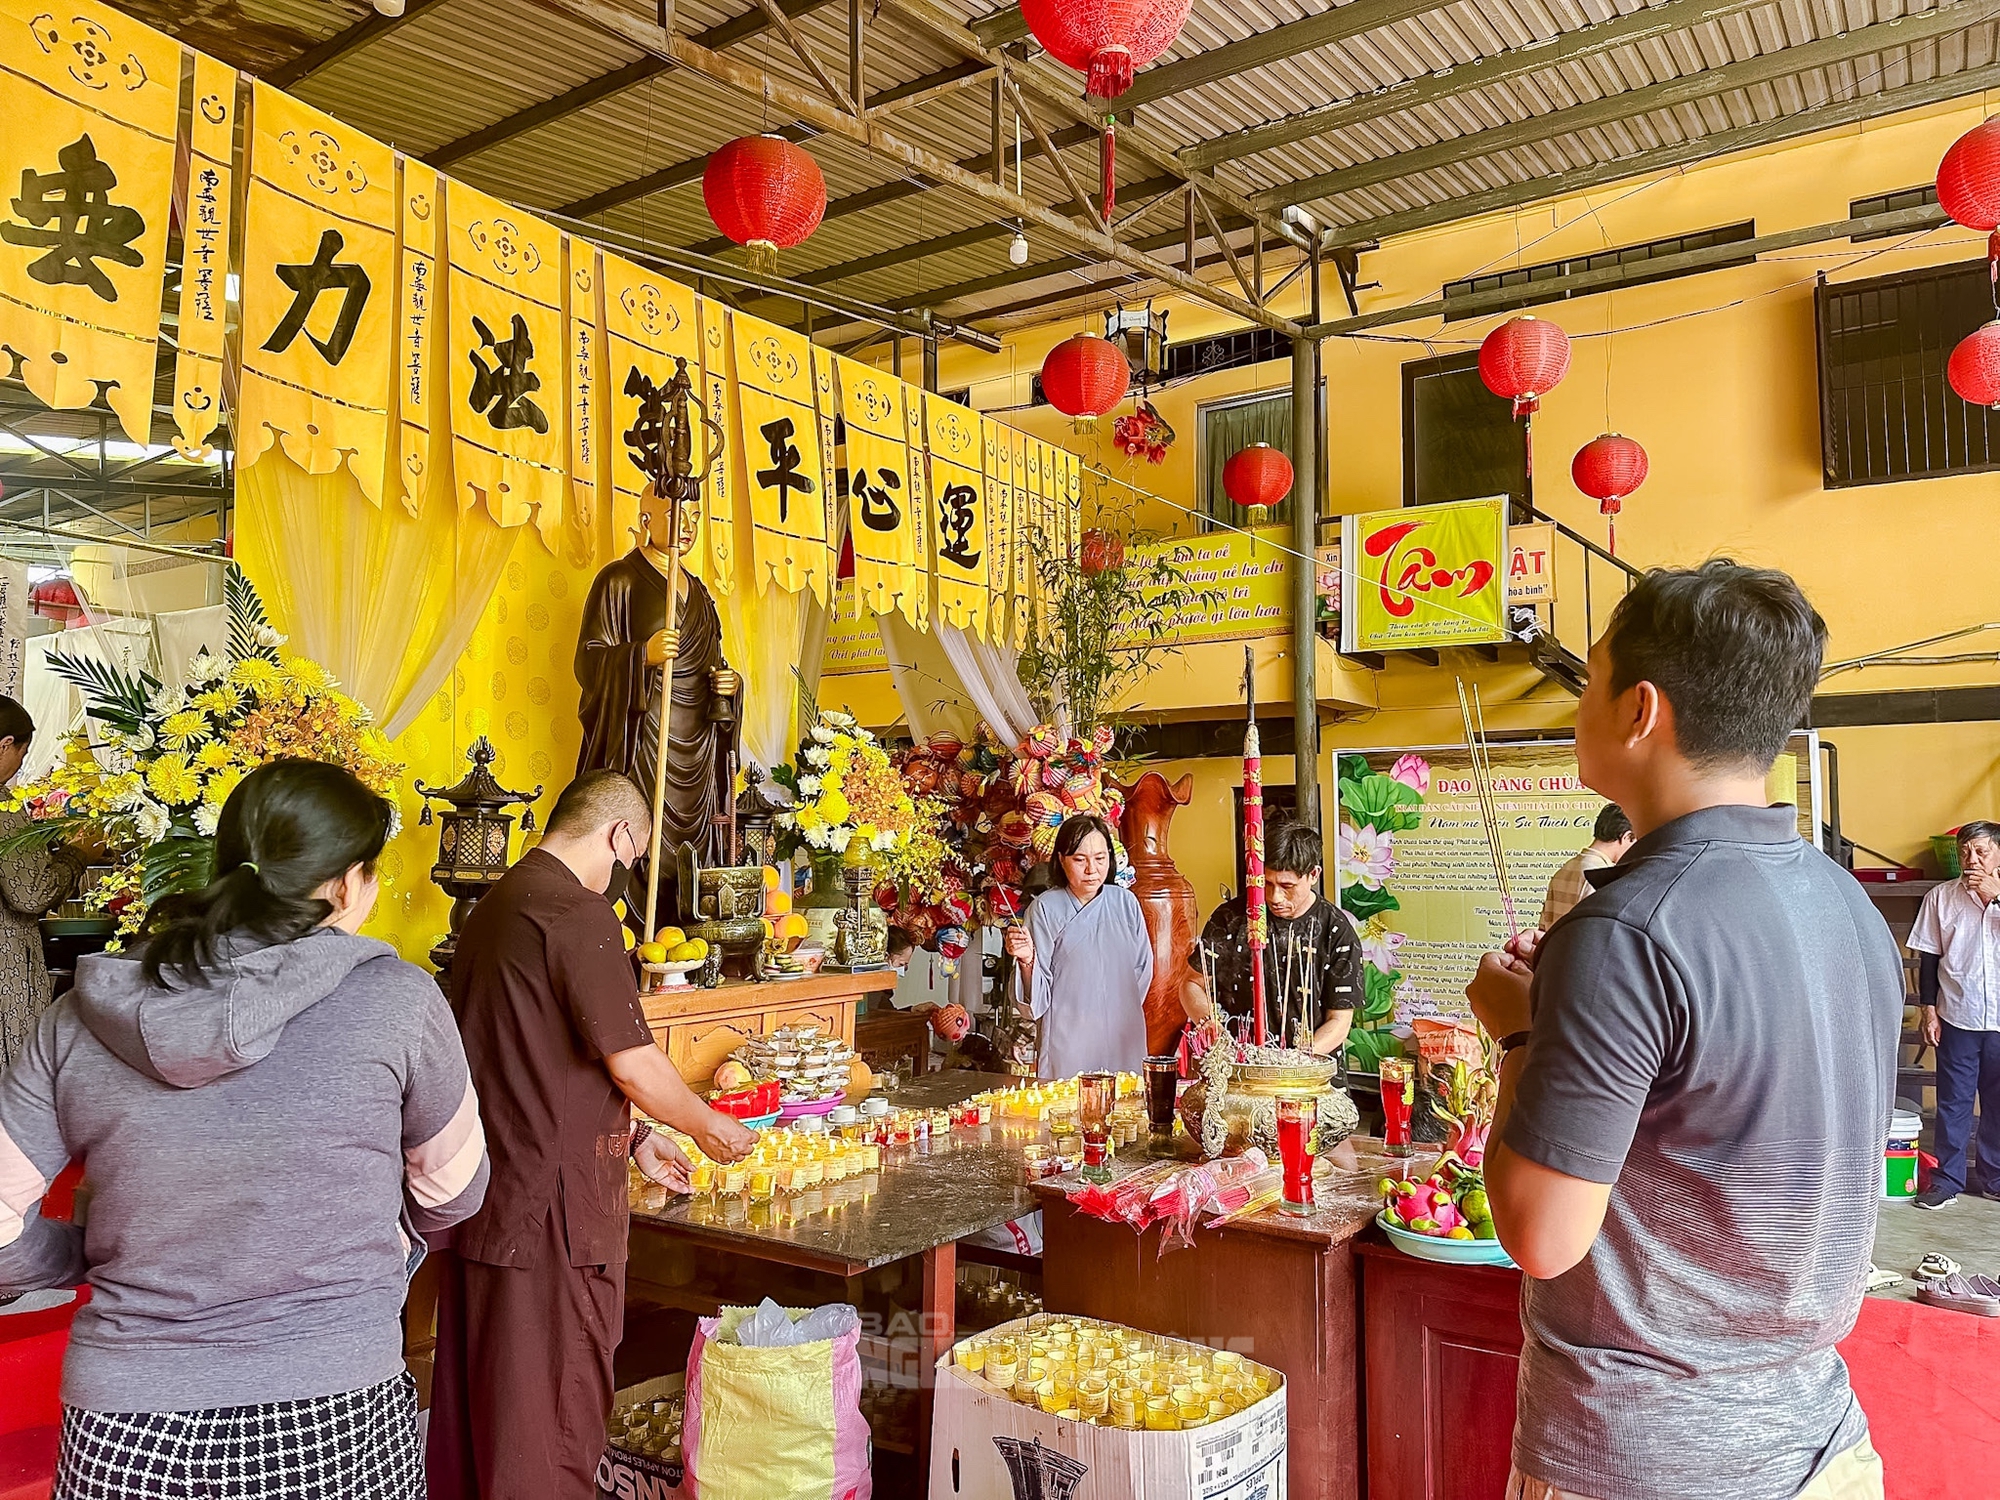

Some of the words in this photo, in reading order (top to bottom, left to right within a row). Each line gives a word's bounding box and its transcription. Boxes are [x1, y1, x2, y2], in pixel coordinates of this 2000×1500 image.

[259, 229, 372, 366] 力
[467, 313, 549, 434] 法
[755, 417, 815, 524] 平
[852, 467, 901, 532] 心
[938, 481, 982, 570] 運
[1198, 548, 1212, 562] ta
[1215, 543, 1230, 558] về
[1325, 553, 1338, 563] Xin
[1242, 562, 1260, 577] hà
[1263, 559, 1285, 573] chi
[1364, 521, 1495, 618] Tâm
[1254, 603, 1281, 618] hơn
[1438, 778, 1472, 796] ĐẠO
[1538, 773, 1587, 792] CHÙA
[1428, 817, 1459, 829] Nam
[1246, 1469, 1266, 1491] APPLES
